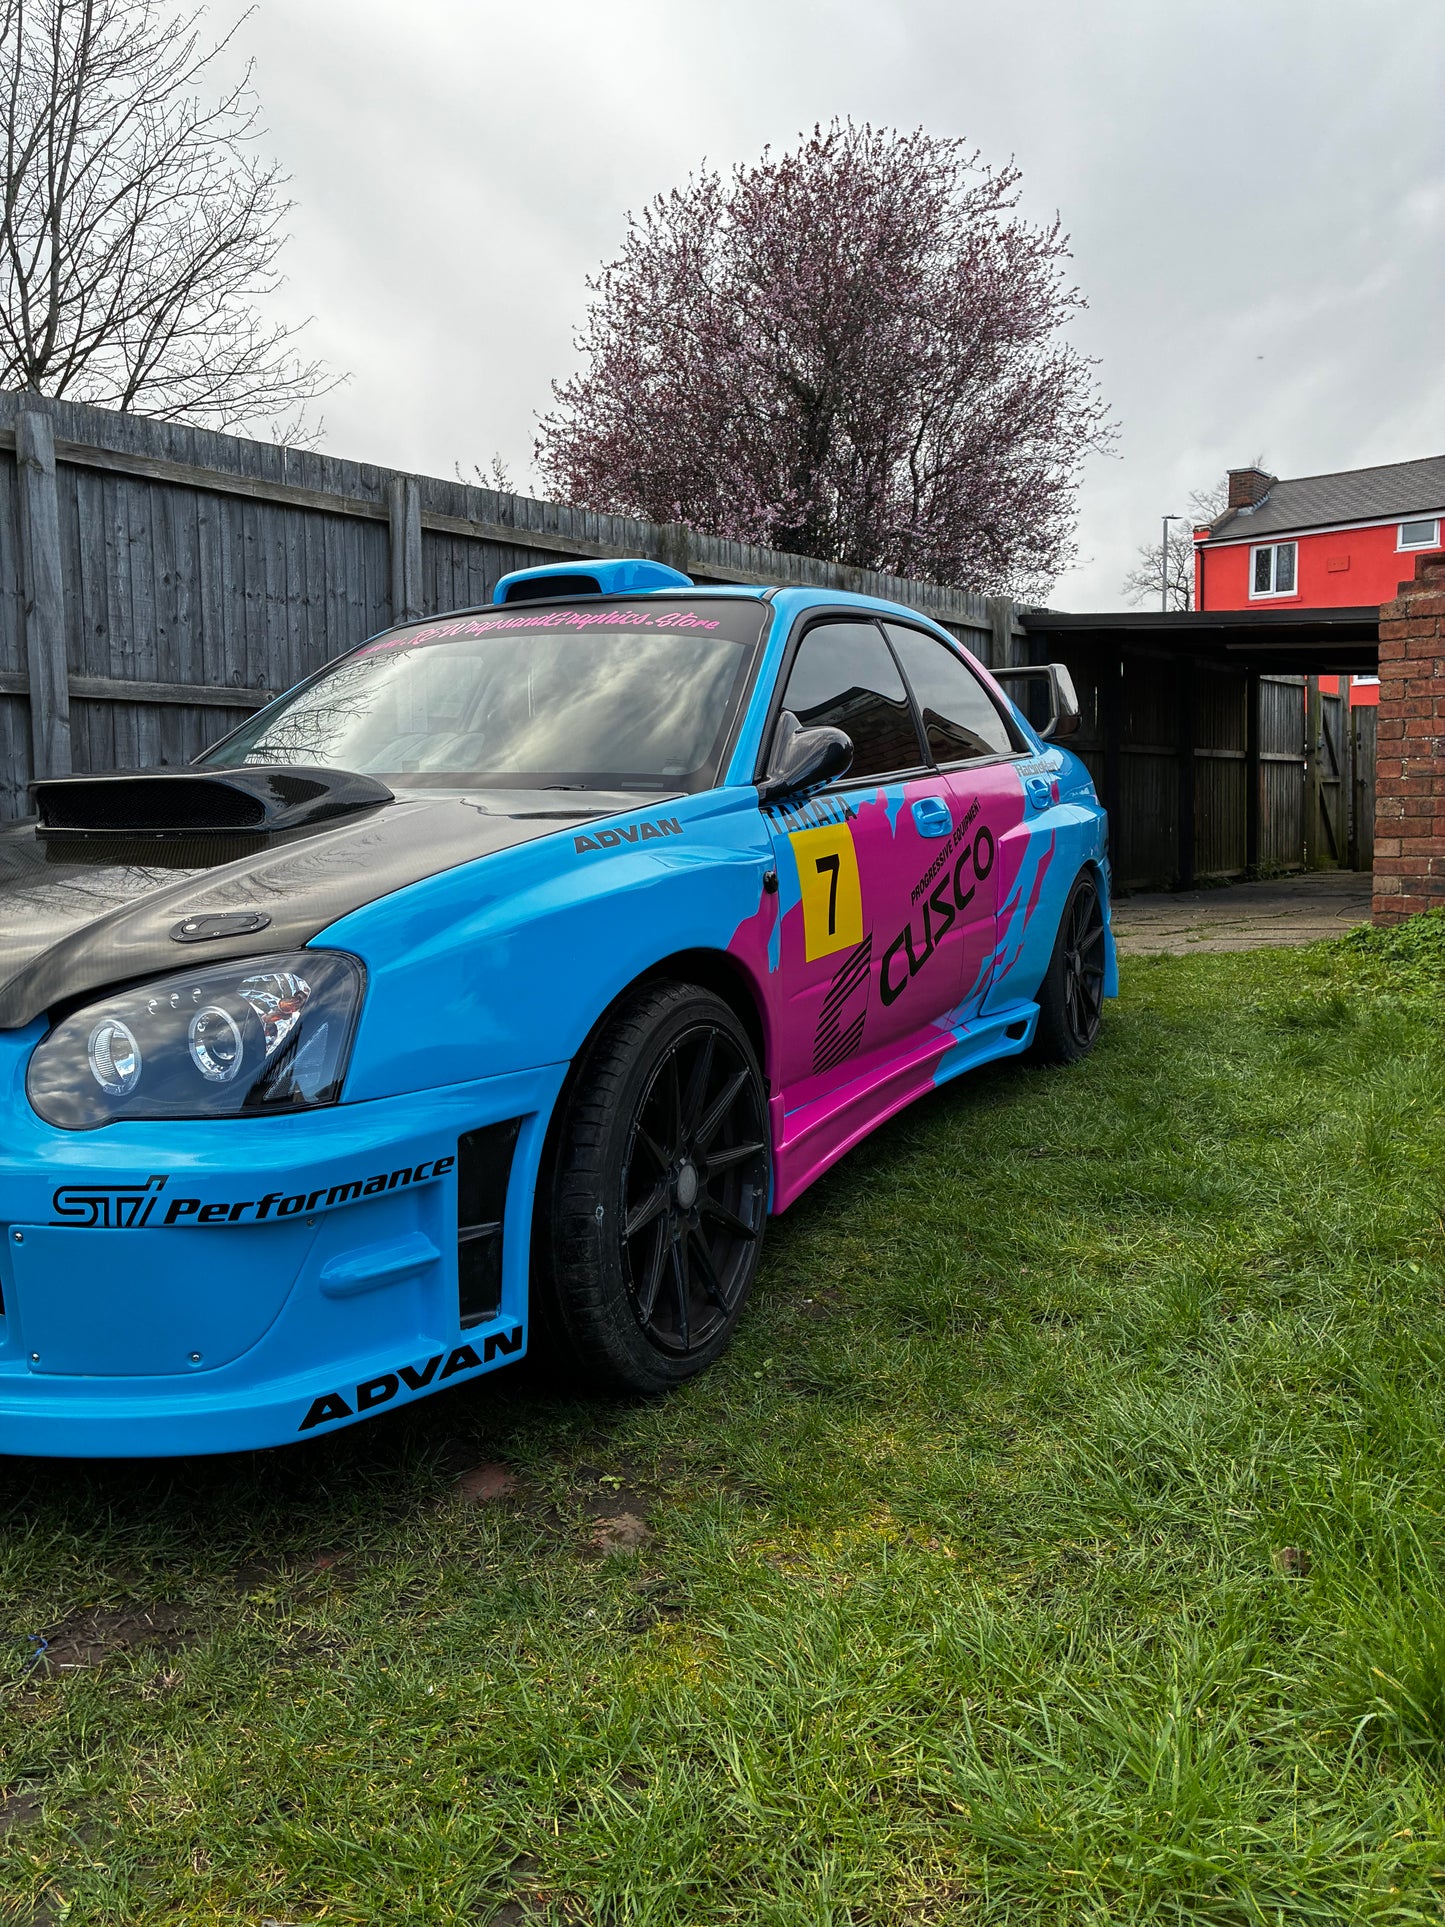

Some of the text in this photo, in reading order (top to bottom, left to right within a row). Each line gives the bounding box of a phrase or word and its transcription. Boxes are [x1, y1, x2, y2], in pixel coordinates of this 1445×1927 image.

[573, 817, 684, 854] ADVAN
[760, 796, 857, 834] TAKATA
[910, 797, 981, 907] PROGRESSIVE EQUIPMENT
[815, 853, 840, 936] 7
[880, 826, 994, 1007] CUSCO
[164, 1156, 456, 1225] Performance
[298, 1325, 523, 1432] ADVAN
